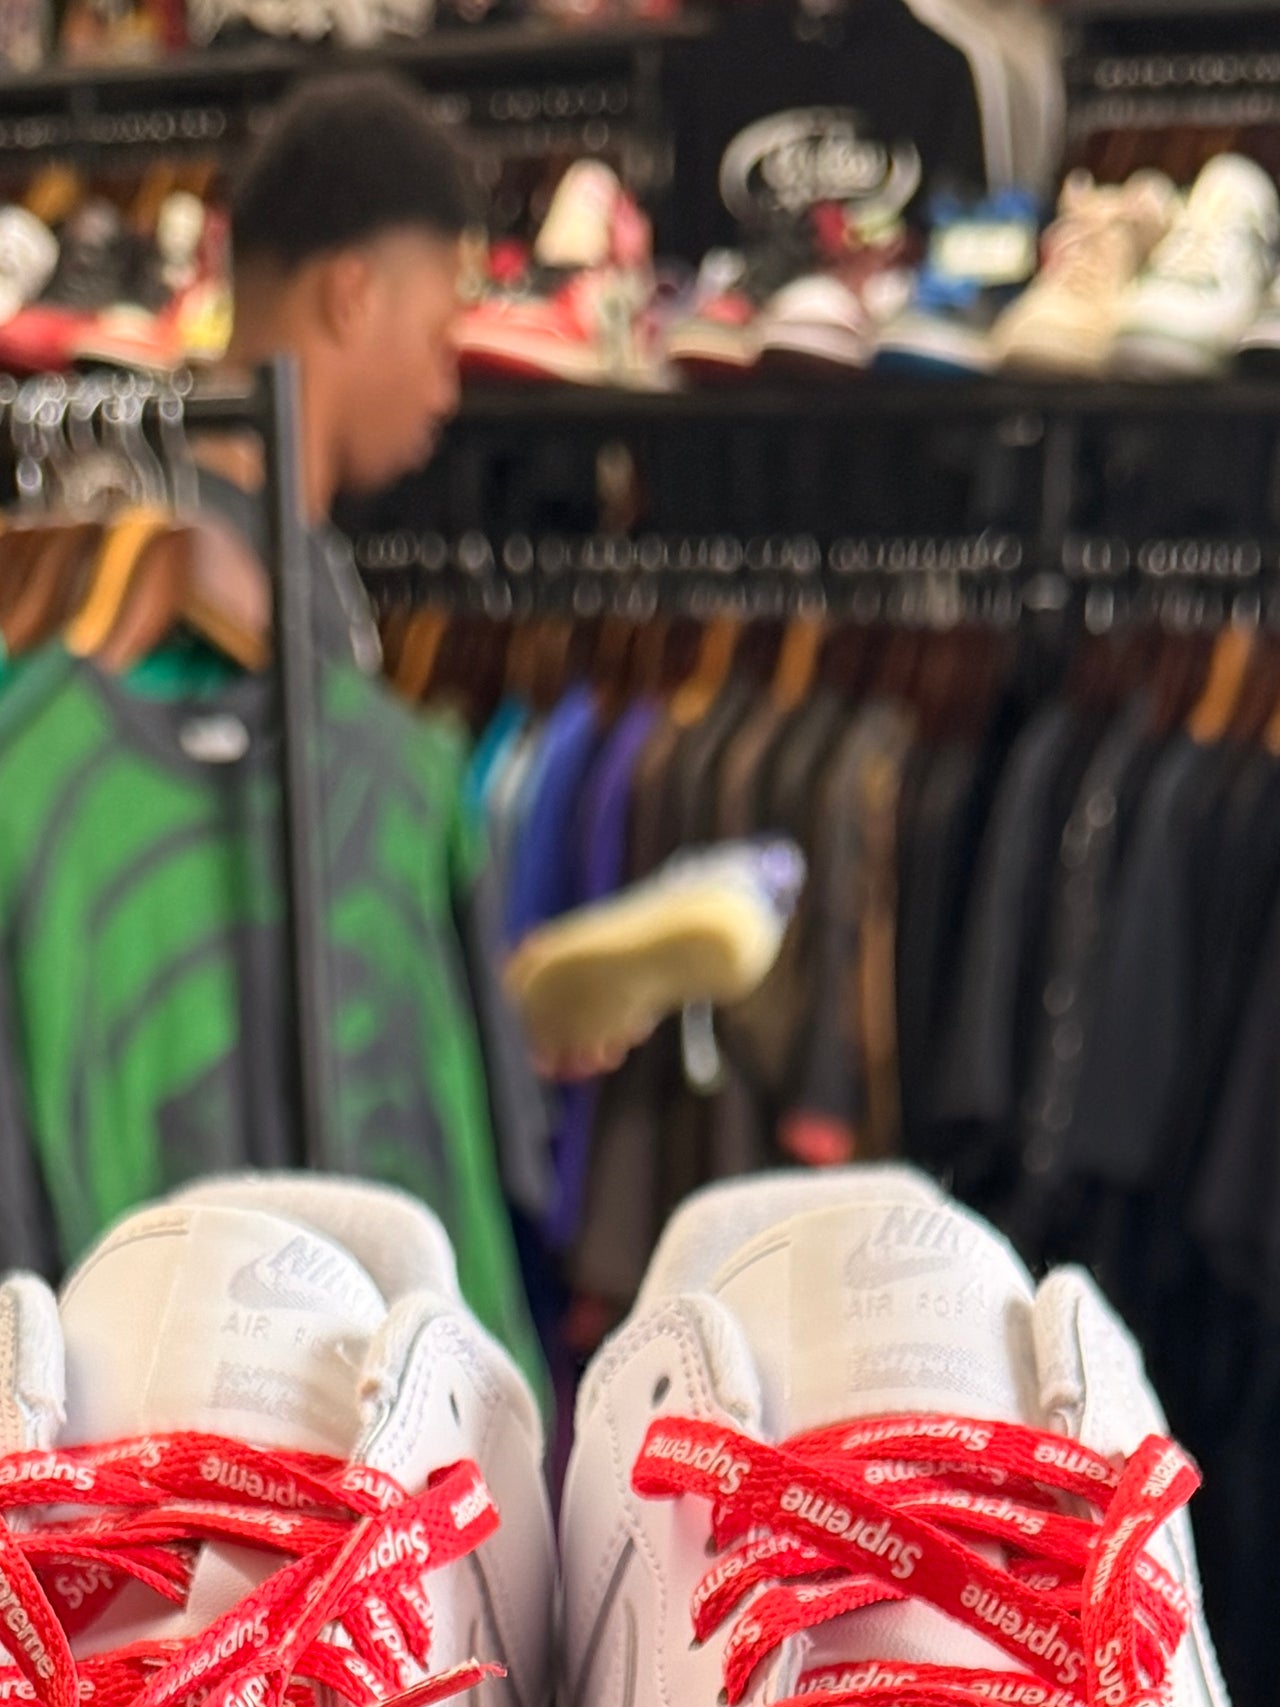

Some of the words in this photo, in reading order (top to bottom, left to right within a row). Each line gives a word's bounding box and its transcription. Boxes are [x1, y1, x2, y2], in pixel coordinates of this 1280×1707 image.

[352, 1521, 432, 1585] Supr
[643, 1434, 752, 1496] Supreme
[778, 1482, 924, 1580] Supreme
[959, 1581, 1088, 1686] Supreme
